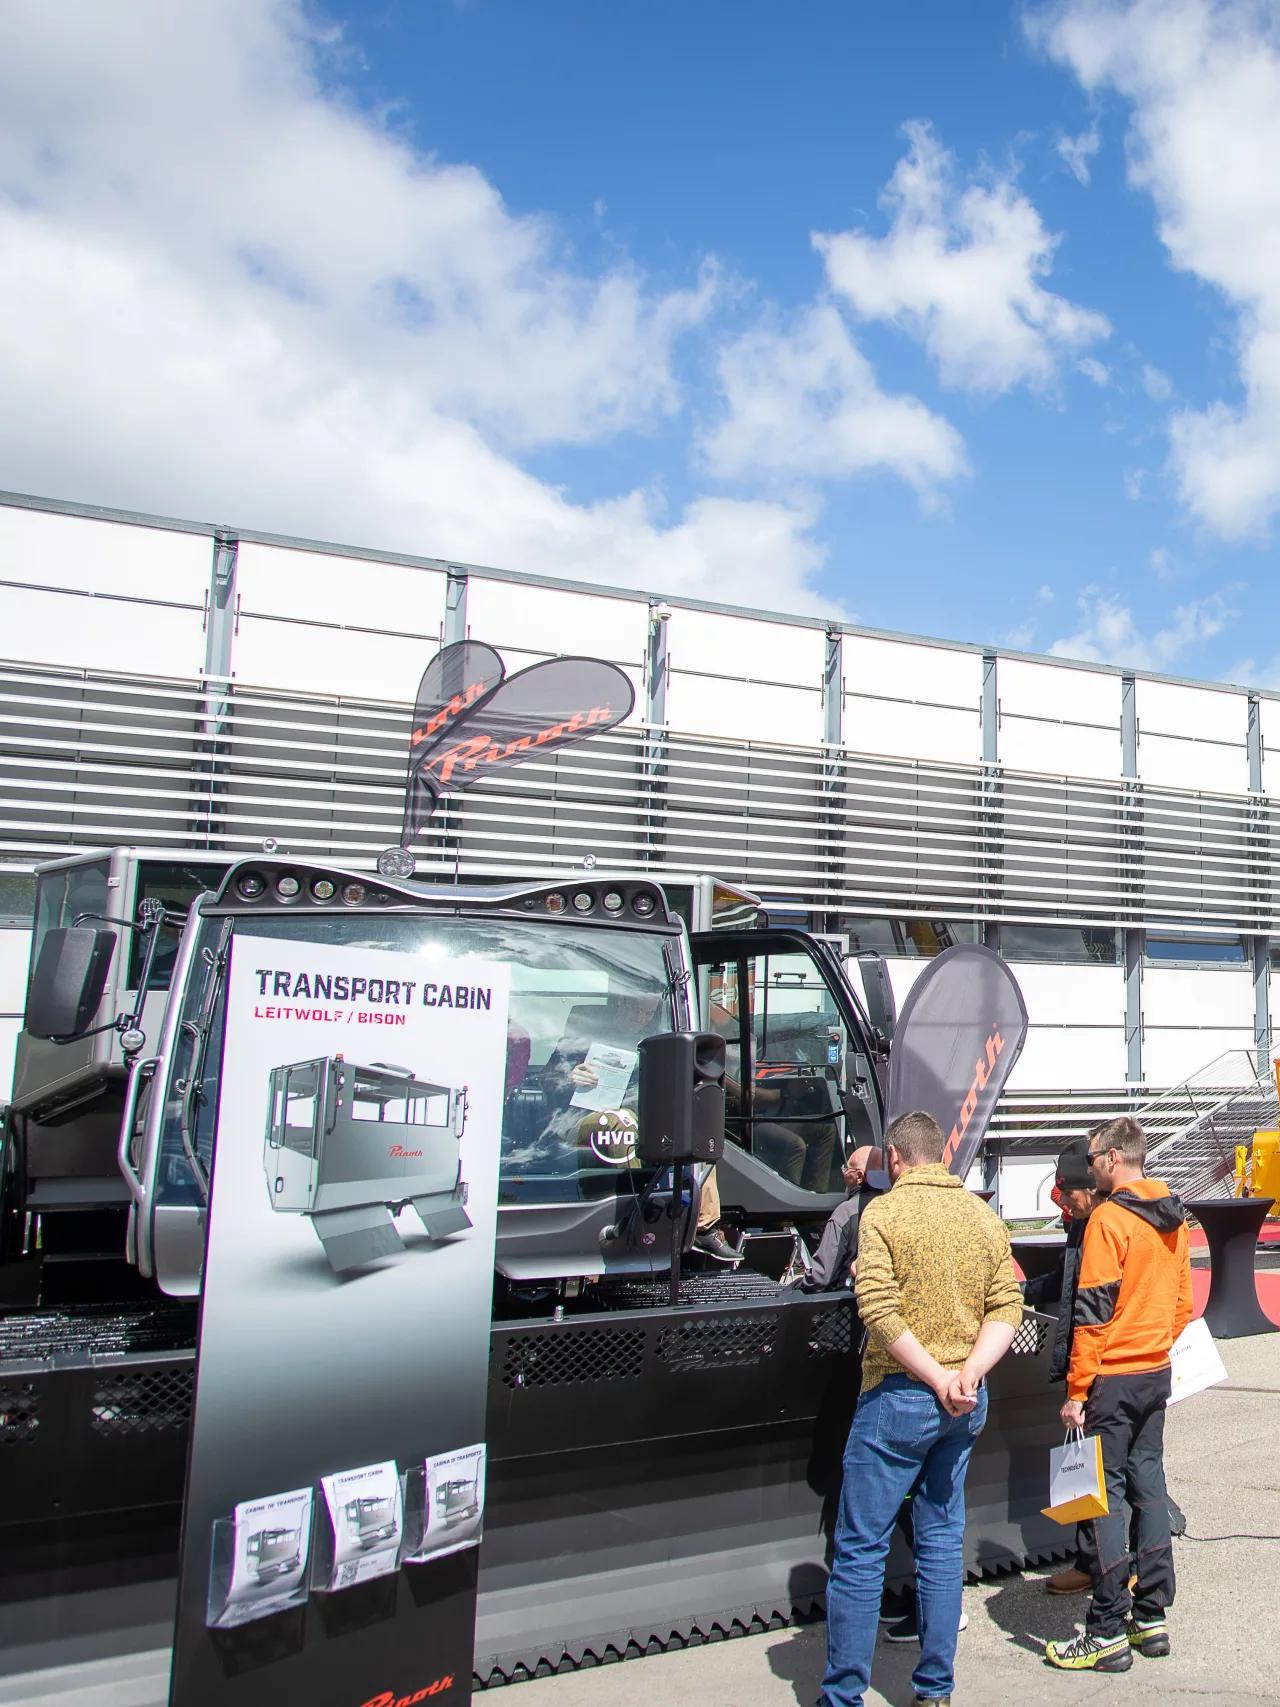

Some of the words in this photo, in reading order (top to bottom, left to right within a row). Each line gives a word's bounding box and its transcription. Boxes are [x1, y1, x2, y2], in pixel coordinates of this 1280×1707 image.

[255, 969, 416, 1005] TRANSPORT
[254, 1006, 343, 1022] LEITWOLF
[358, 1012, 406, 1025] BISON
[597, 1131, 635, 1145] HVO
